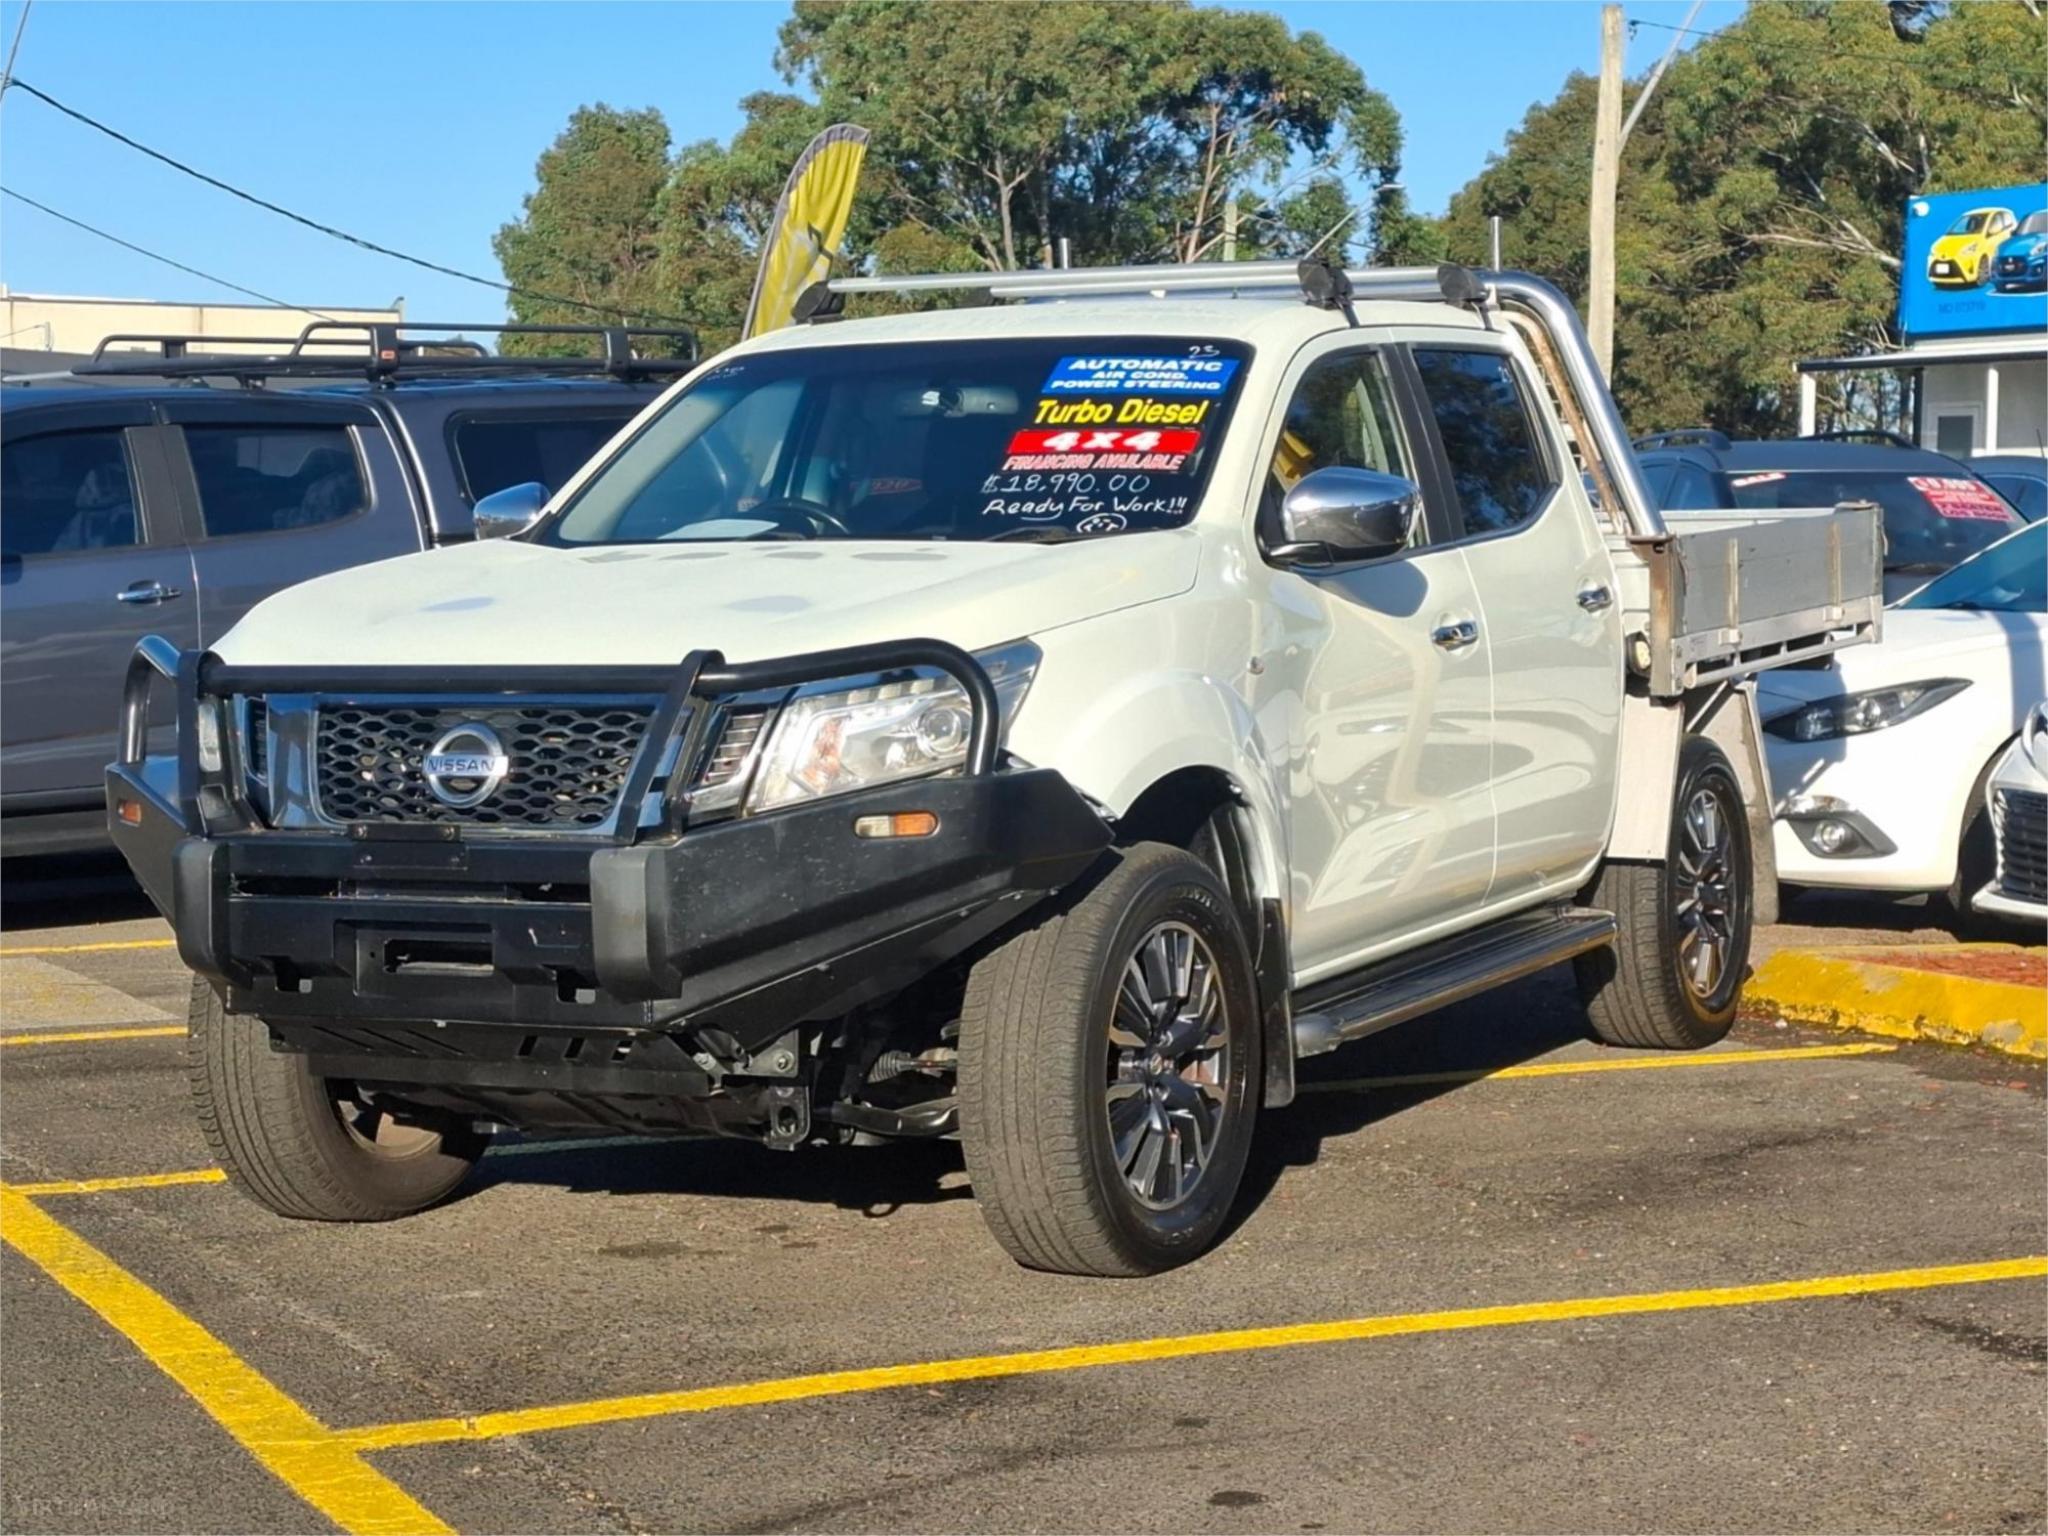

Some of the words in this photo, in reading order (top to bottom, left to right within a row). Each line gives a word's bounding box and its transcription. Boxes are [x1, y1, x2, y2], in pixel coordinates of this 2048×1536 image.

[1068, 359, 1222, 372] AUTOMATIC
[1091, 371, 1125, 380] AIR
[1131, 371, 1188, 380] COND.
[1051, 380, 1119, 389] POWER
[1123, 380, 1221, 390] STEERING
[1034, 399, 1113, 424] Turbo
[1116, 399, 1209, 424] Diesel
[1001, 454, 1095, 471] FINANCING
[1092, 453, 1186, 470] AVAILABLE
[982, 498, 1064, 521] Ready
[1068, 496, 1104, 512] For
[426, 758, 496, 772] NISSAN
